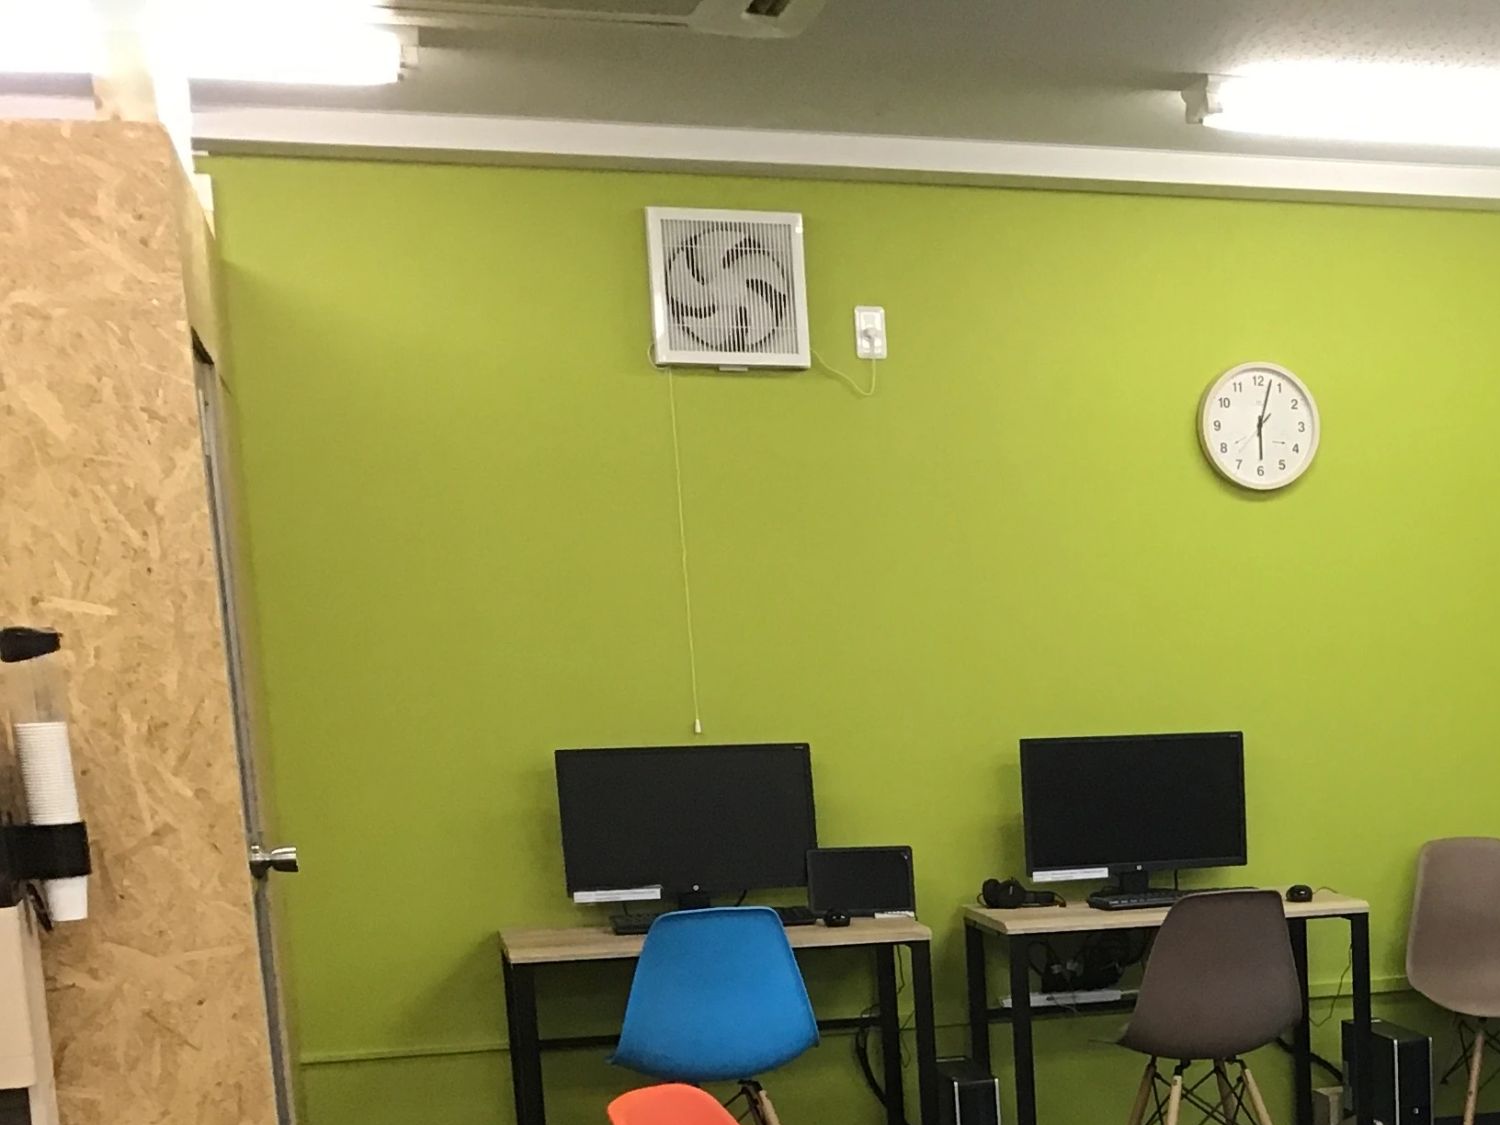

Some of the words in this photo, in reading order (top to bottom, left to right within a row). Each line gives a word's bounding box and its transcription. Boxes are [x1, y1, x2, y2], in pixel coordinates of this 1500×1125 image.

[1252, 376, 1265, 387] 12
[1232, 382, 1243, 393] 11
[1277, 382, 1283, 393] 1
[1218, 397, 1231, 408] 10
[1290, 399, 1299, 409] 2
[1213, 420, 1222, 431] 9
[1298, 422, 1306, 432] 3
[1220, 442, 1228, 453] 8
[1291, 443, 1300, 454] 4
[1235, 459, 1243, 470] 7
[1278, 460, 1286, 470] 5
[1257, 466, 1265, 476] 6
